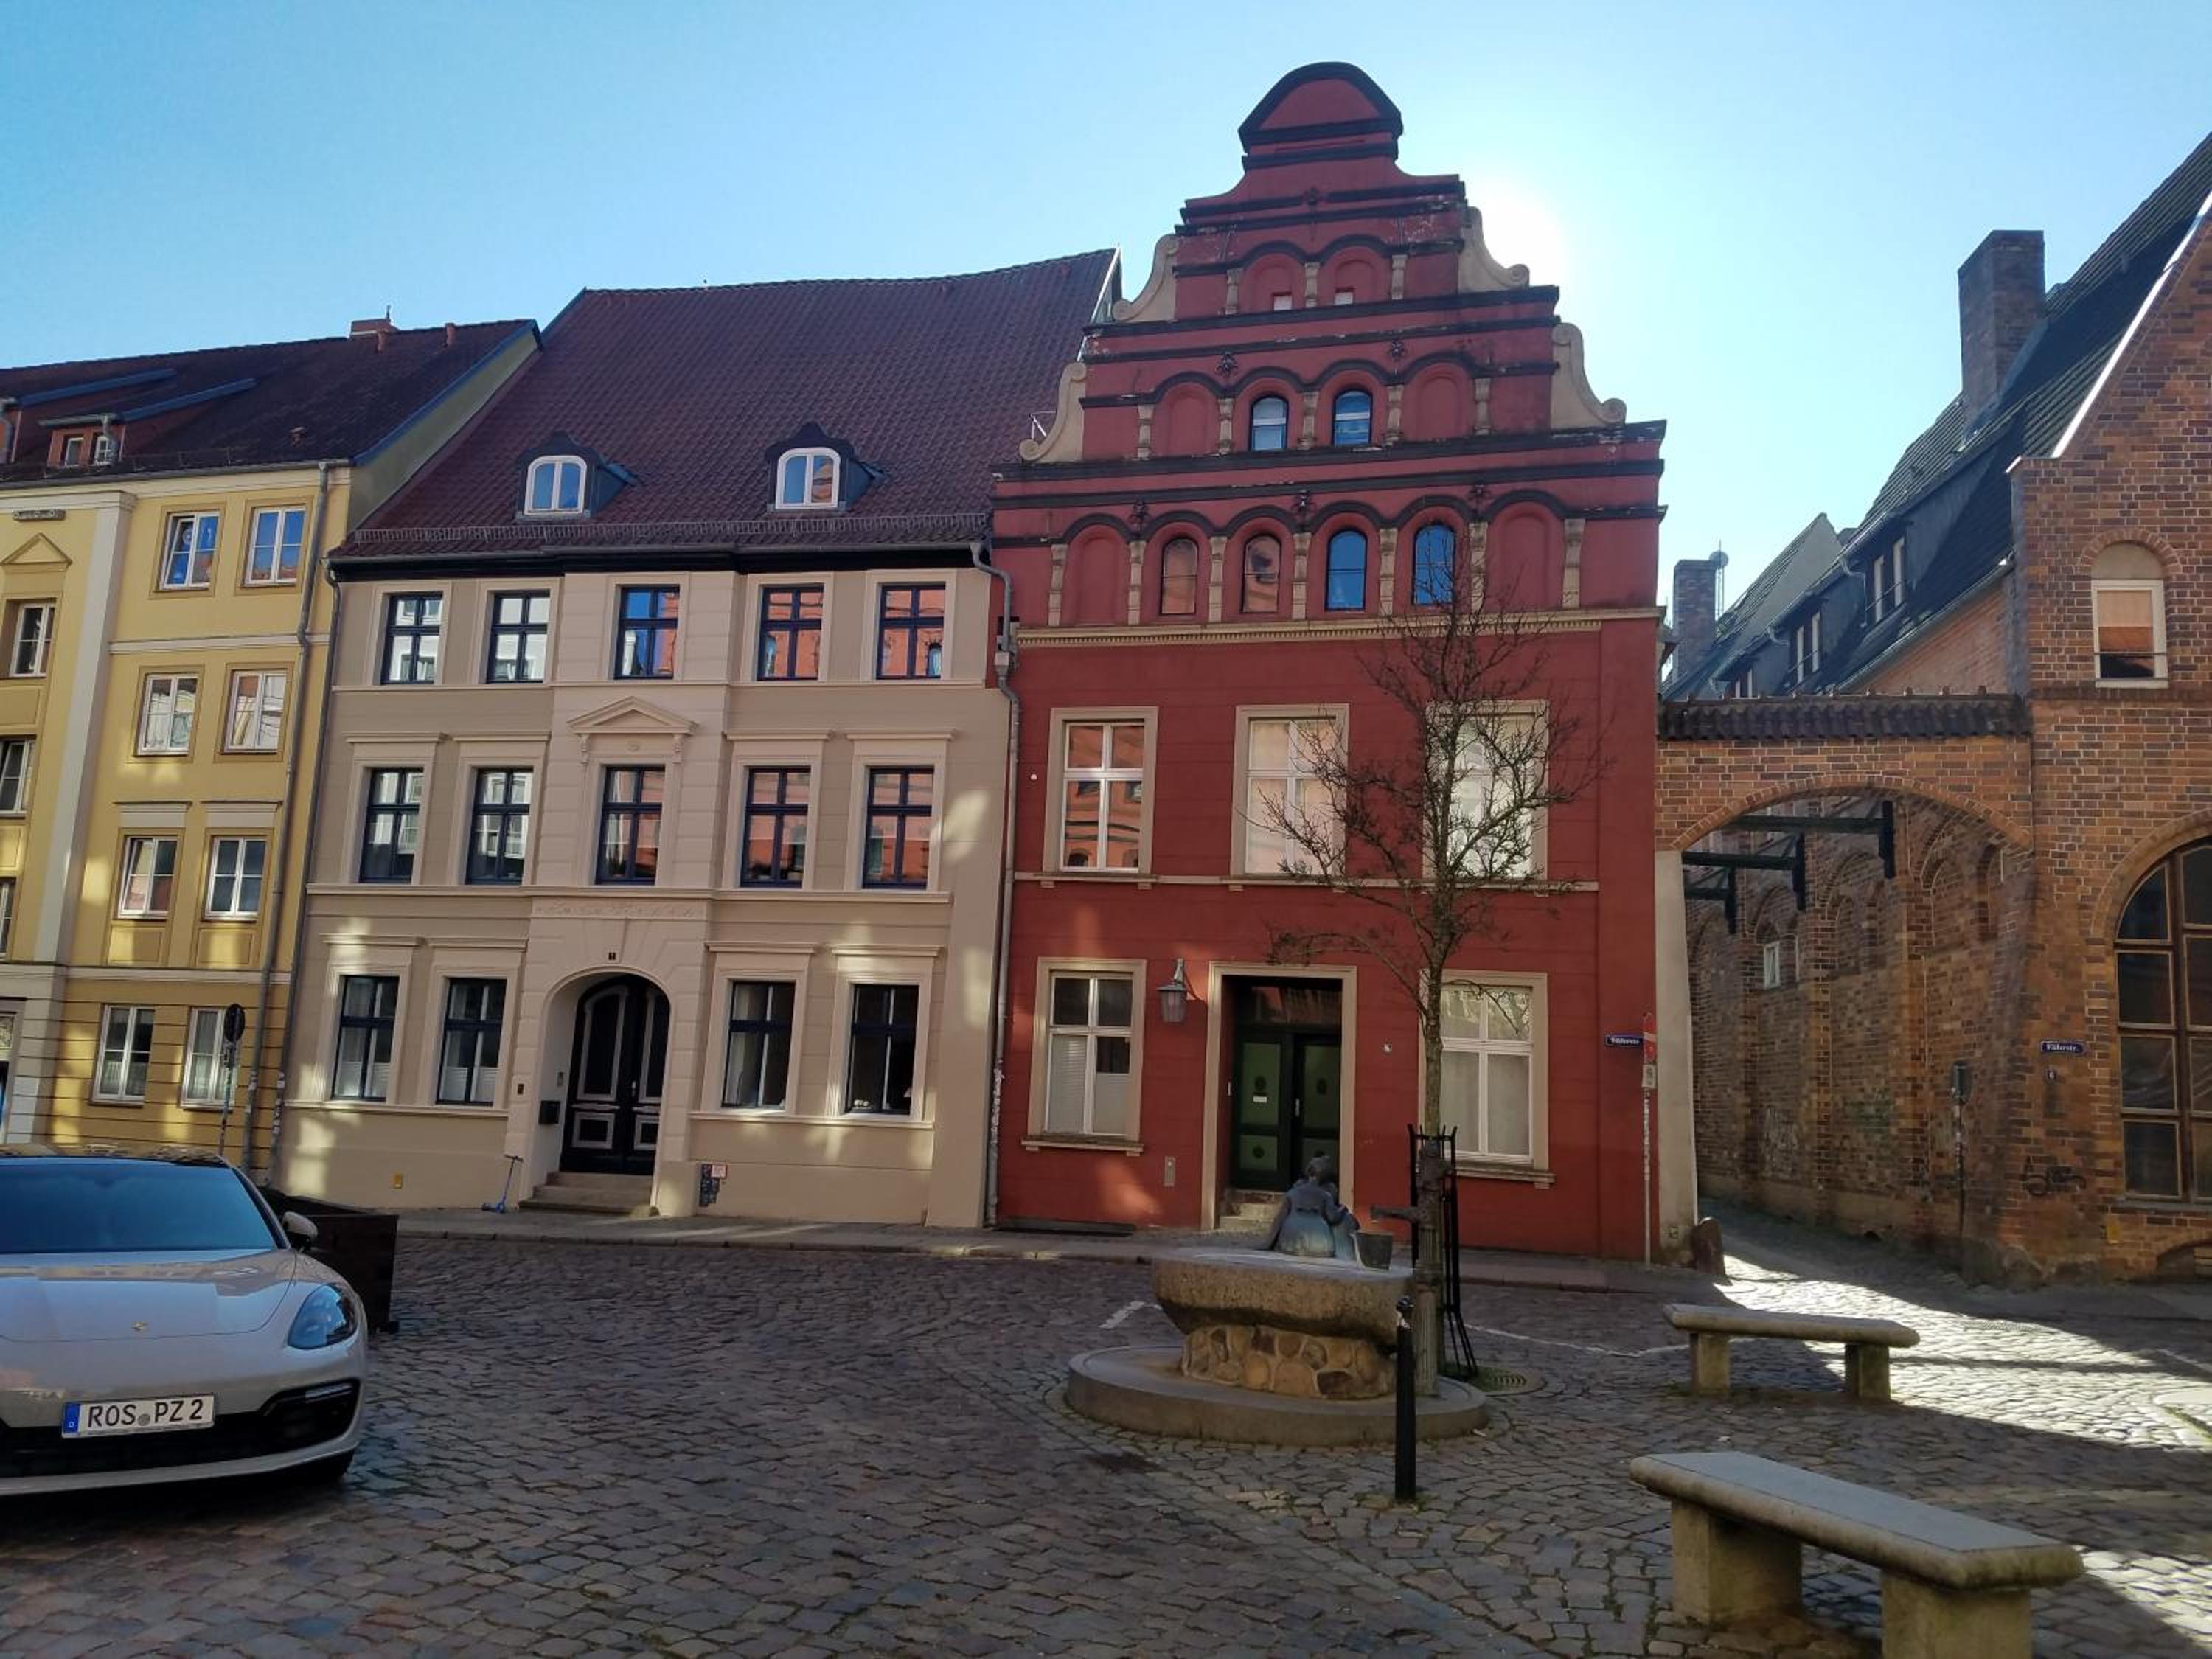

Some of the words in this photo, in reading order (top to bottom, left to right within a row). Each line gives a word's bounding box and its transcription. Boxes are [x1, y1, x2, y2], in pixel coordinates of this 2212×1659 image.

[88, 1404, 136, 1427] ROS
[154, 1400, 185, 1423] PZ
[189, 1399, 203, 1421] 2
